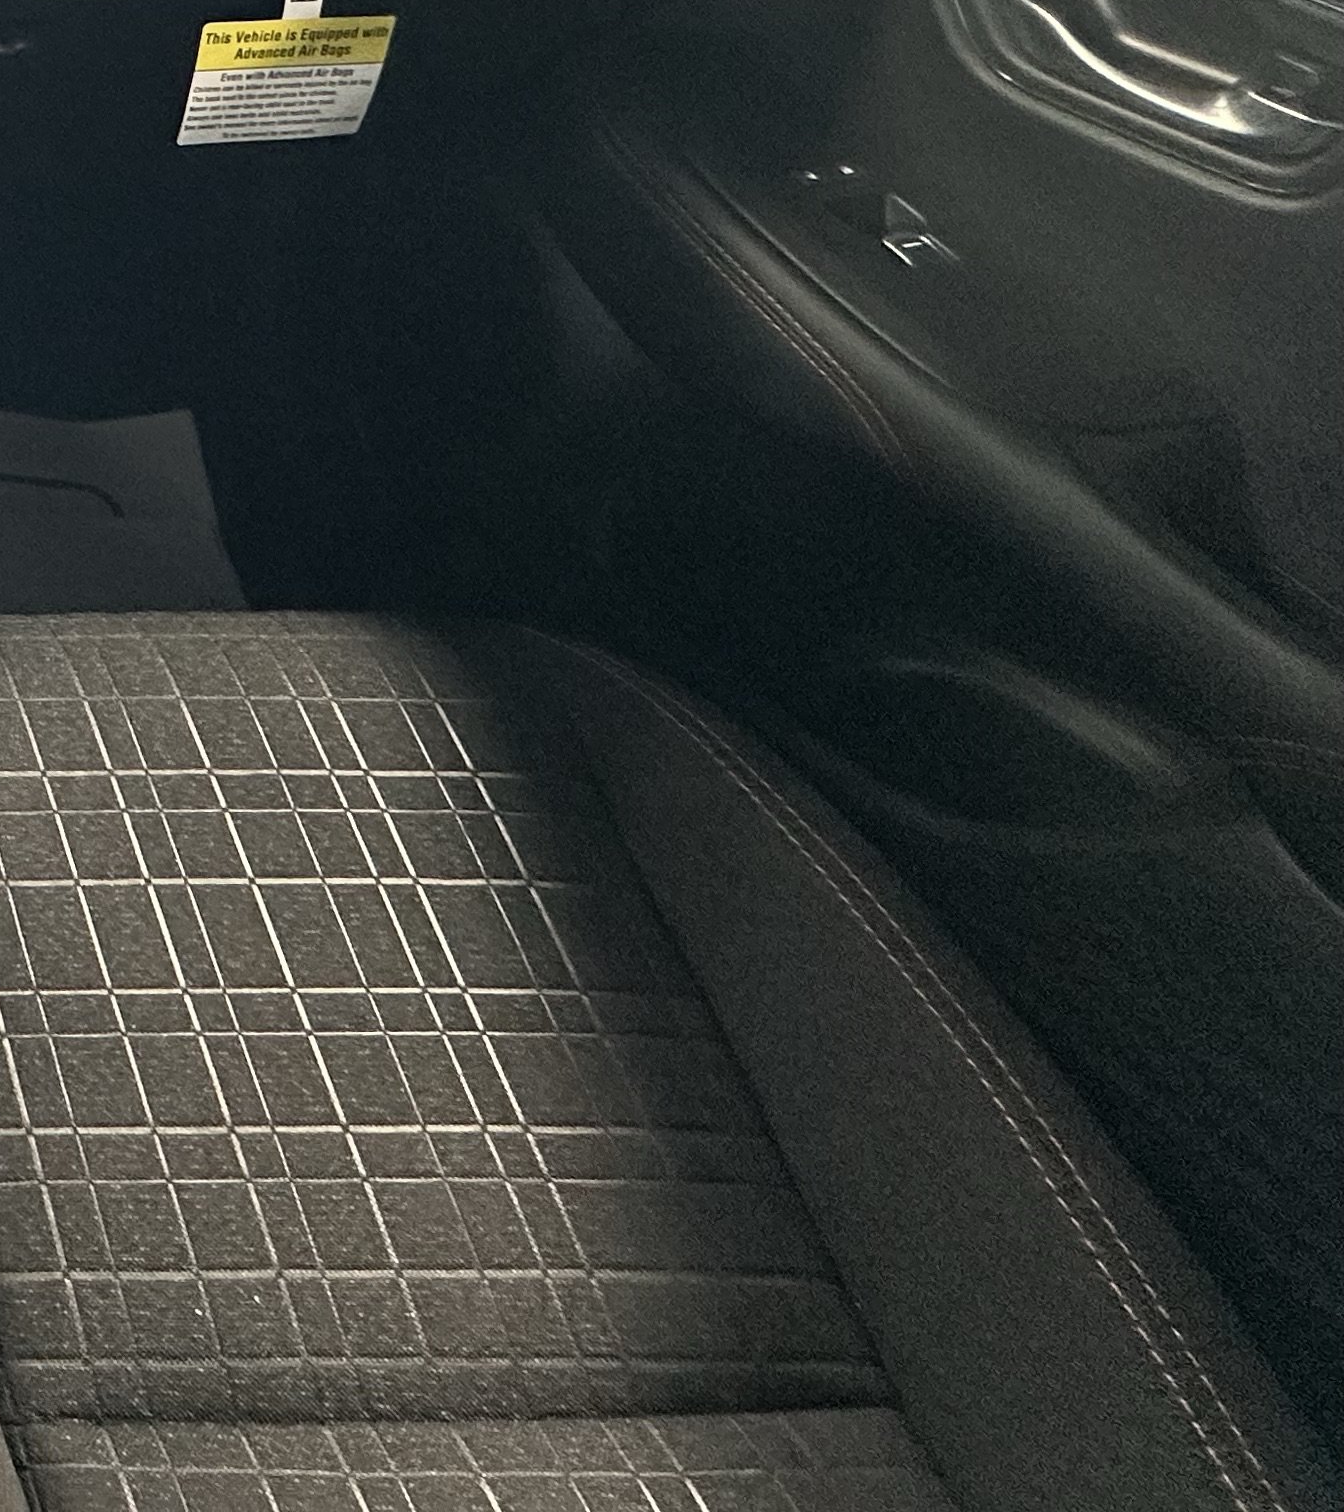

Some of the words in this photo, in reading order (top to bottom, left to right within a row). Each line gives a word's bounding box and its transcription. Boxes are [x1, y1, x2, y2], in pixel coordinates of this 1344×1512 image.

[206, 32, 231, 45] This
[236, 29, 282, 43] Vehicle
[285, 28, 297, 41] is
[300, 27, 358, 42] Equipped
[362, 26, 389, 38] with
[234, 45, 295, 60] Advanced
[298, 44, 317, 58] Air
[320, 43, 352, 58] Bags
[267, 68, 314, 80] Advanced
